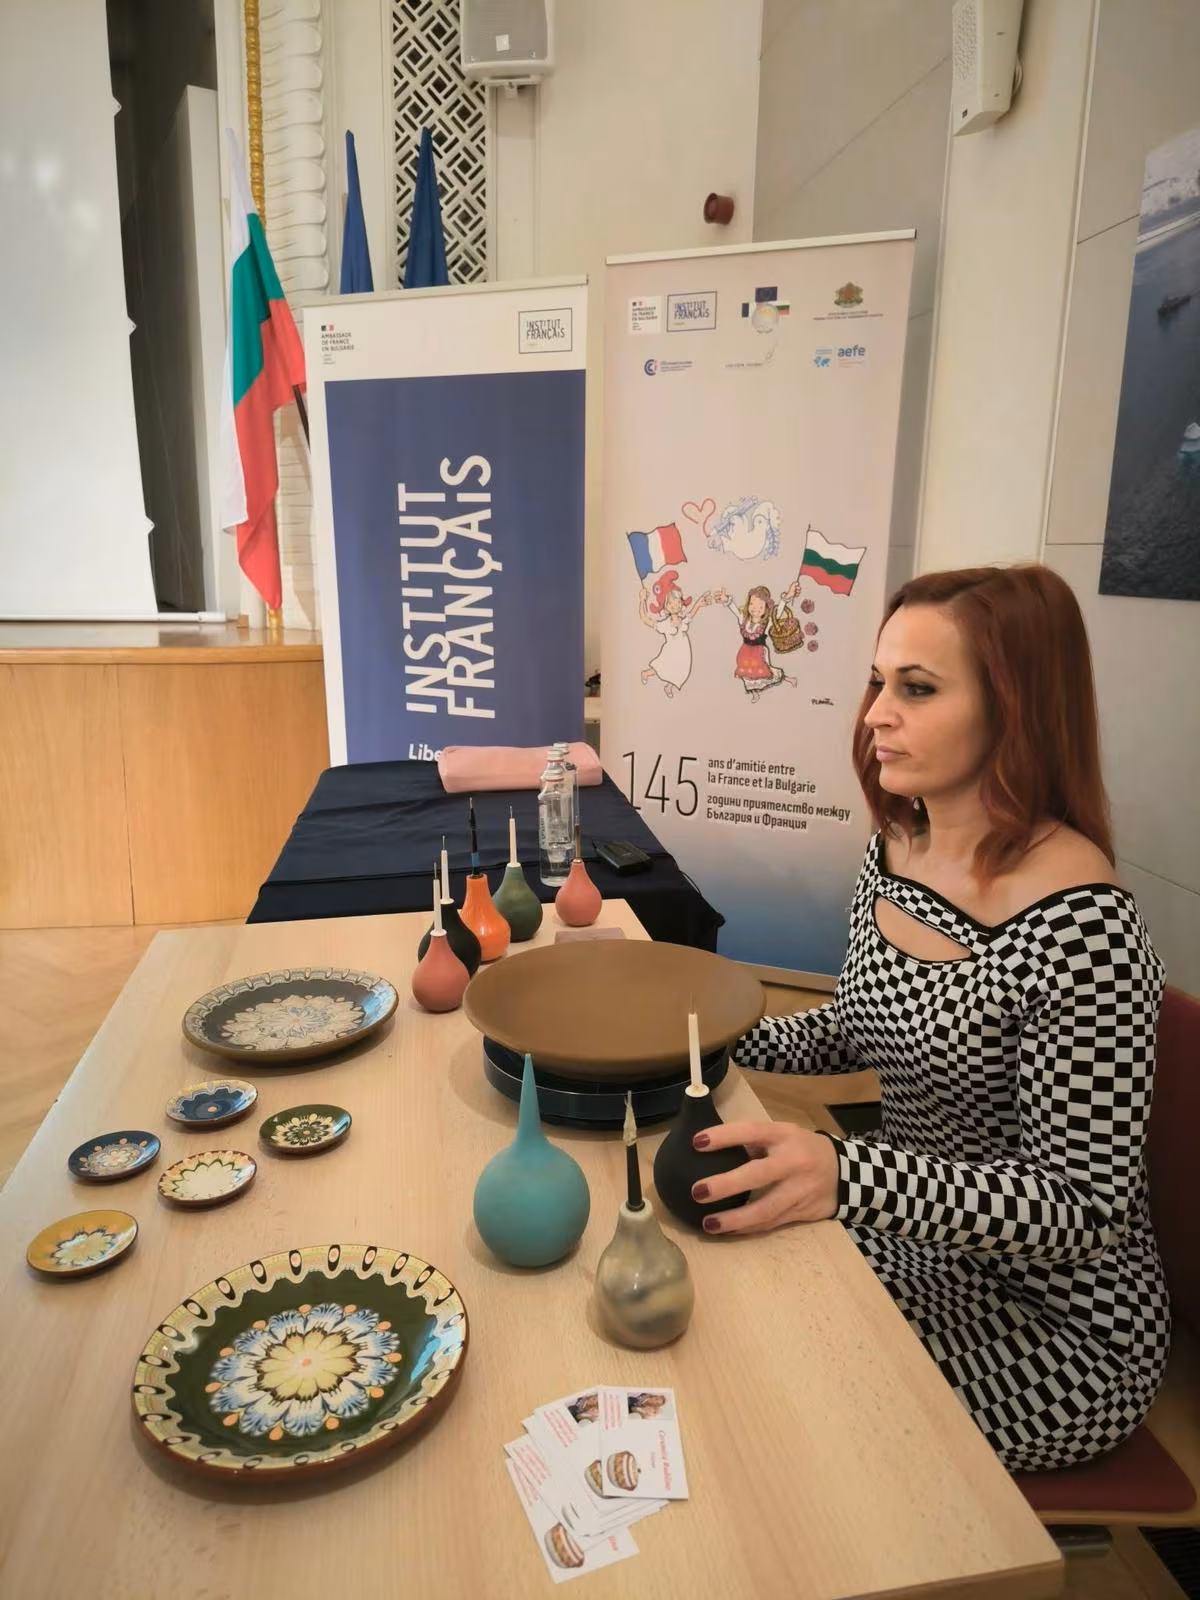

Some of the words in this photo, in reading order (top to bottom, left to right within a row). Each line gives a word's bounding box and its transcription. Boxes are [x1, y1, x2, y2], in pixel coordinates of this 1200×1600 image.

[526, 318, 561, 331] INSTITUT
[838, 344, 866, 357] aefe
[398, 482, 451, 714] INSTITUT
[440, 455, 503, 719] FRANÇAIS
[408, 743, 441, 762] Libe
[708, 759, 725, 769] ans
[726, 758, 766, 773] d'amitié
[768, 764, 795, 776] entre
[623, 751, 698, 816] 145
[707, 771, 716, 783] la
[718, 772, 750, 787] France
[752, 777, 763, 788] et
[764, 776, 773, 789] la
[775, 778, 816, 795] Bulgarie
[706, 807, 752, 825] България
[754, 815, 760, 824] и
[762, 813, 807, 830] Франция
[707, 795, 741, 808] години
[743, 799, 814, 815] приятелство
[816, 805, 851, 821] между
